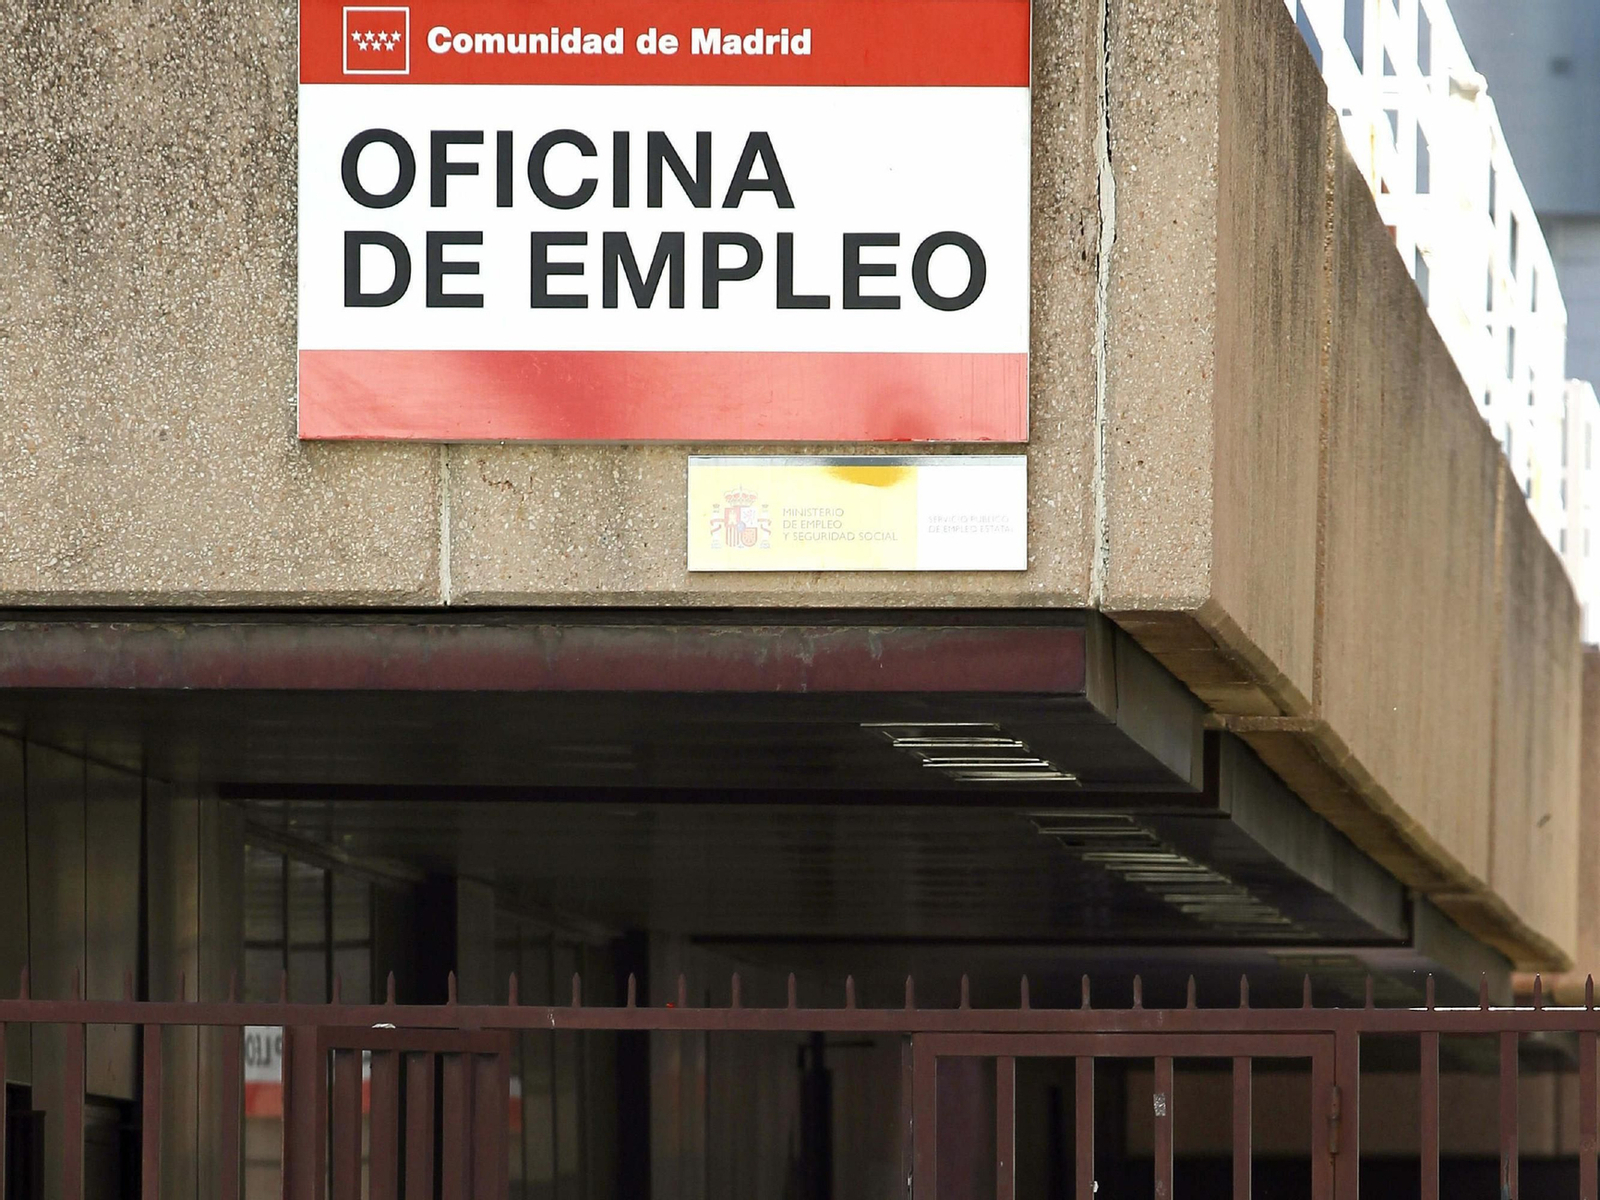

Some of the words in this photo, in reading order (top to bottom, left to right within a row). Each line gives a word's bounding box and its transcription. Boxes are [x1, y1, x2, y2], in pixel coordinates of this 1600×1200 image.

[428, 26, 624, 55] Comunidad
[637, 27, 678, 55] de
[691, 27, 812, 55] Madrid
[341, 128, 796, 210] OFICINA
[344, 230, 484, 309] DE
[530, 230, 987, 312] EMPLEO
[782, 507, 845, 518] MINISTERIO
[782, 519, 798, 530] DE
[800, 519, 843, 530] EMPLEO
[928, 525, 940, 533] DE
[782, 531, 790, 542] Y
[793, 531, 856, 542] SEGURIDAD
[858, 531, 899, 542] SOCIAL
